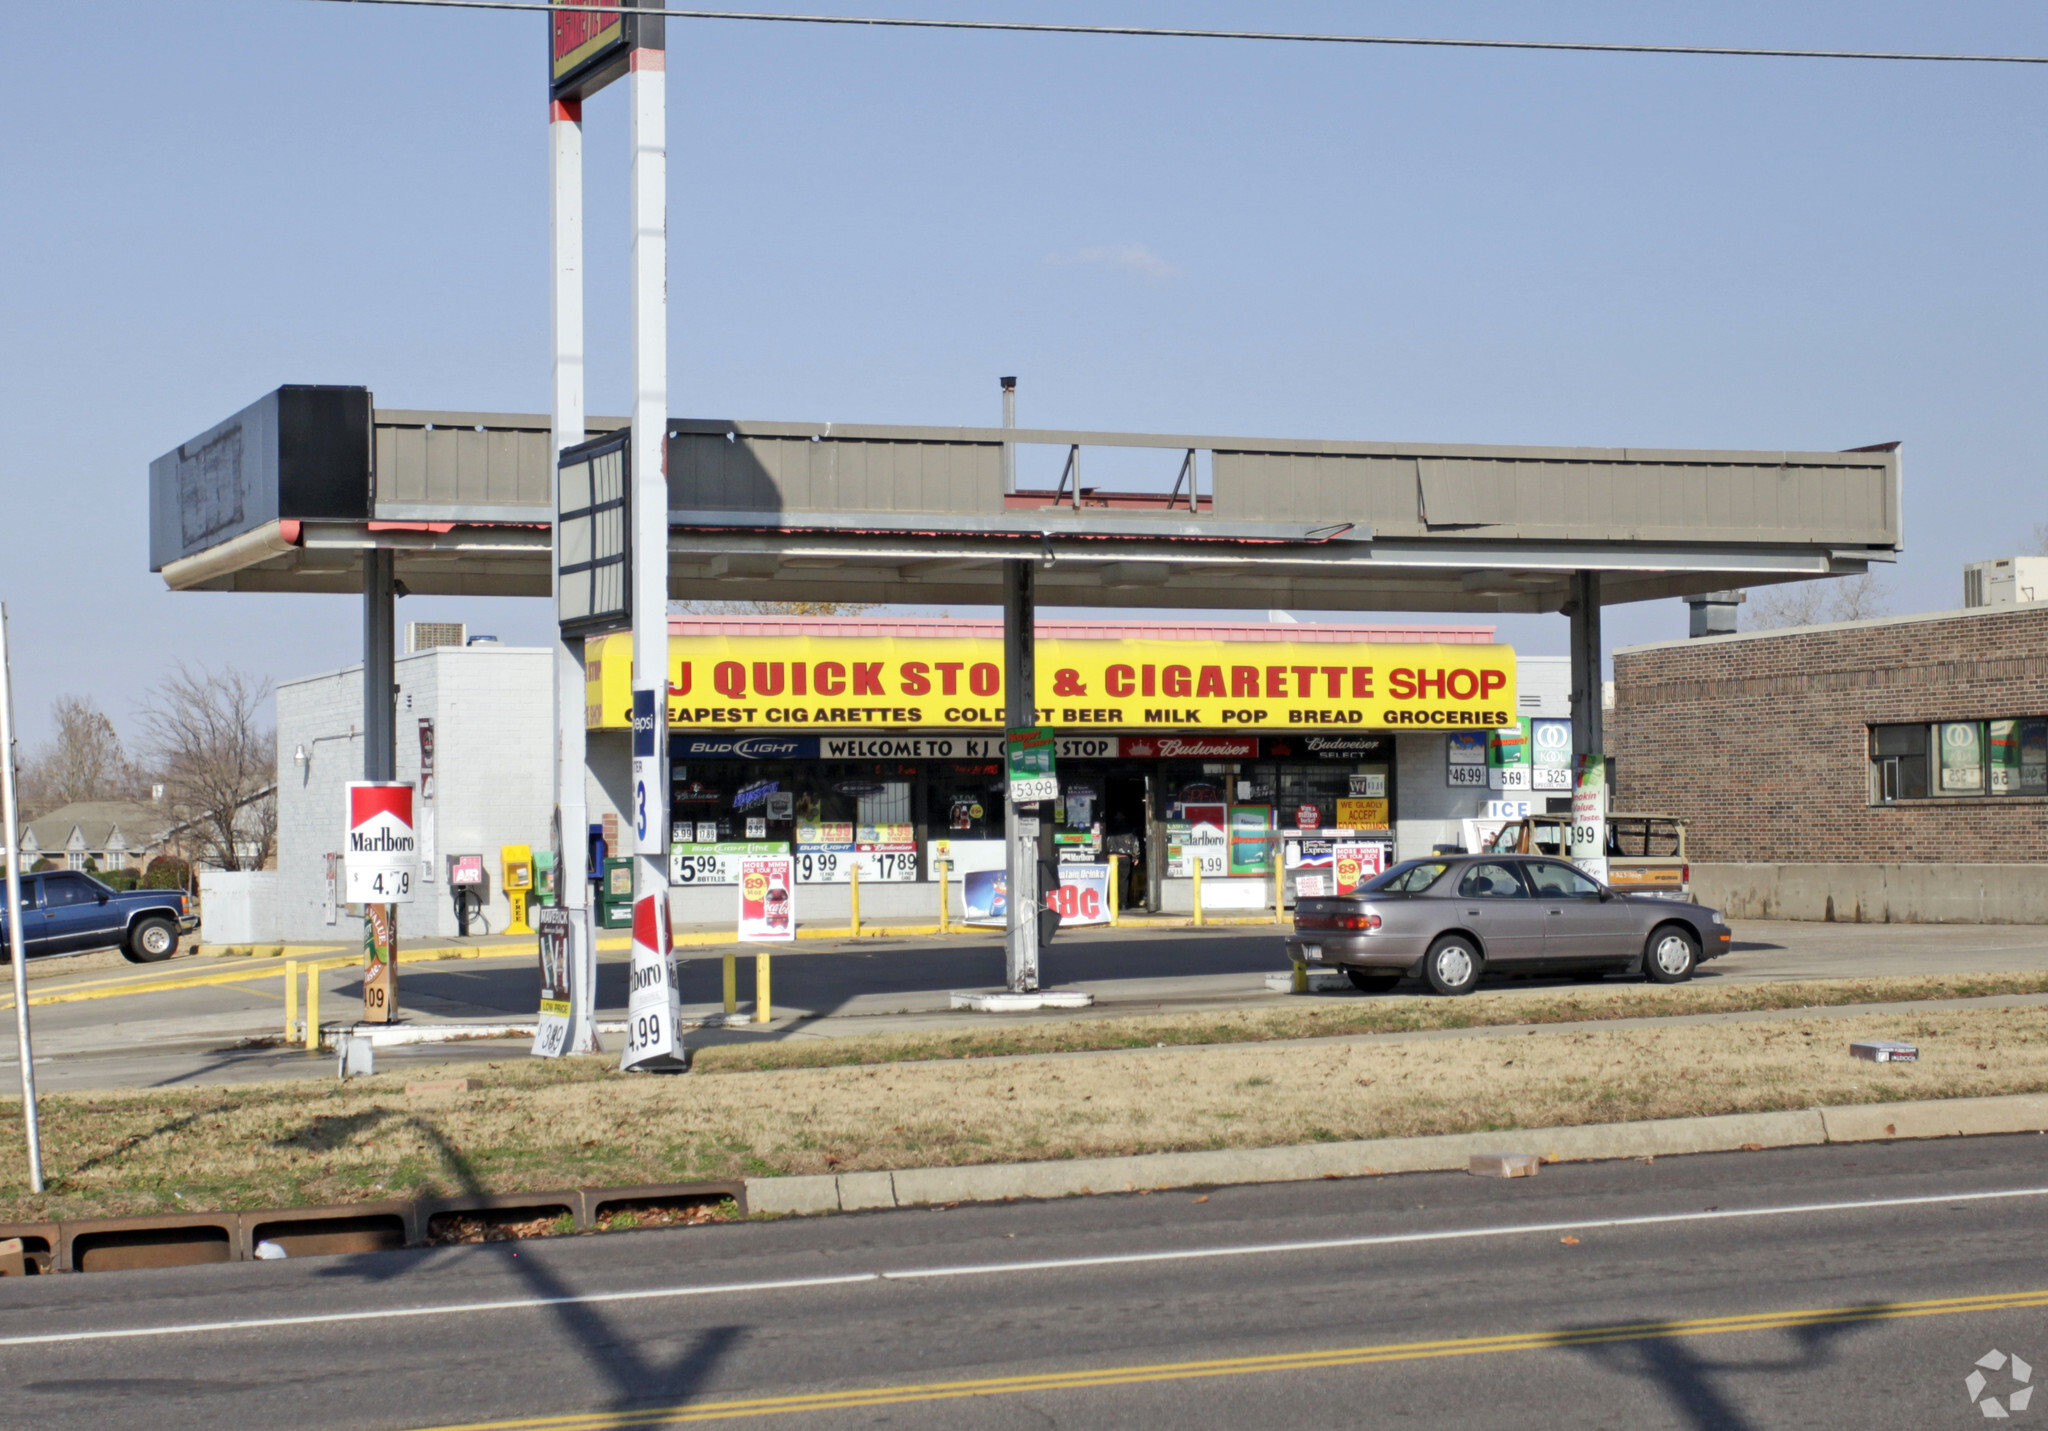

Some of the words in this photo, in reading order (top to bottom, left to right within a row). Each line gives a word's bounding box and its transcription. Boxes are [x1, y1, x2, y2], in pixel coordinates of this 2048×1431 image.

[713, 661, 886, 699] QUICK
[900, 661, 1001, 697] STO
[1052, 668, 1088, 697] &
[1105, 664, 1374, 698] CIGARETTE
[1389, 668, 1506, 700] SHOP
[624, 708, 757, 722] CEAPEST
[765, 708, 922, 722] CIGARETTES
[944, 708, 1055, 722] COLDST
[1063, 709, 1123, 722] BEER
[1145, 709, 1201, 723] MILK
[1222, 710, 1267, 723] POP
[1289, 710, 1363, 724] BREAD
[1383, 710, 1508, 725] GROCERIES
[828, 740, 924, 757] WELCOME
[926, 740, 953, 757] TO
[1063, 740, 1109, 756] STOP
[1158, 739, 1249, 756] Budweiser
[1305, 737, 1379, 751] Budweiser
[1540, 750, 1566, 762] KOOL
[1348, 810, 1377, 820] ACCEPT
[1492, 802, 1528, 817] ICE
[350, 826, 414, 852] Marlboro
[1190, 831, 1224, 846] arlboro
[1303, 847, 1333, 855] Express
[456, 868, 479, 882] AIR
[1080, 869, 1104, 879] Drinks
[372, 872, 410, 895] 4.9
[541, 908, 568, 924] MAVERICK
[631, 958, 661, 993] lboro
[542, 1001, 554, 1011] LOW
[554, 1002, 568, 1014] PRICE
